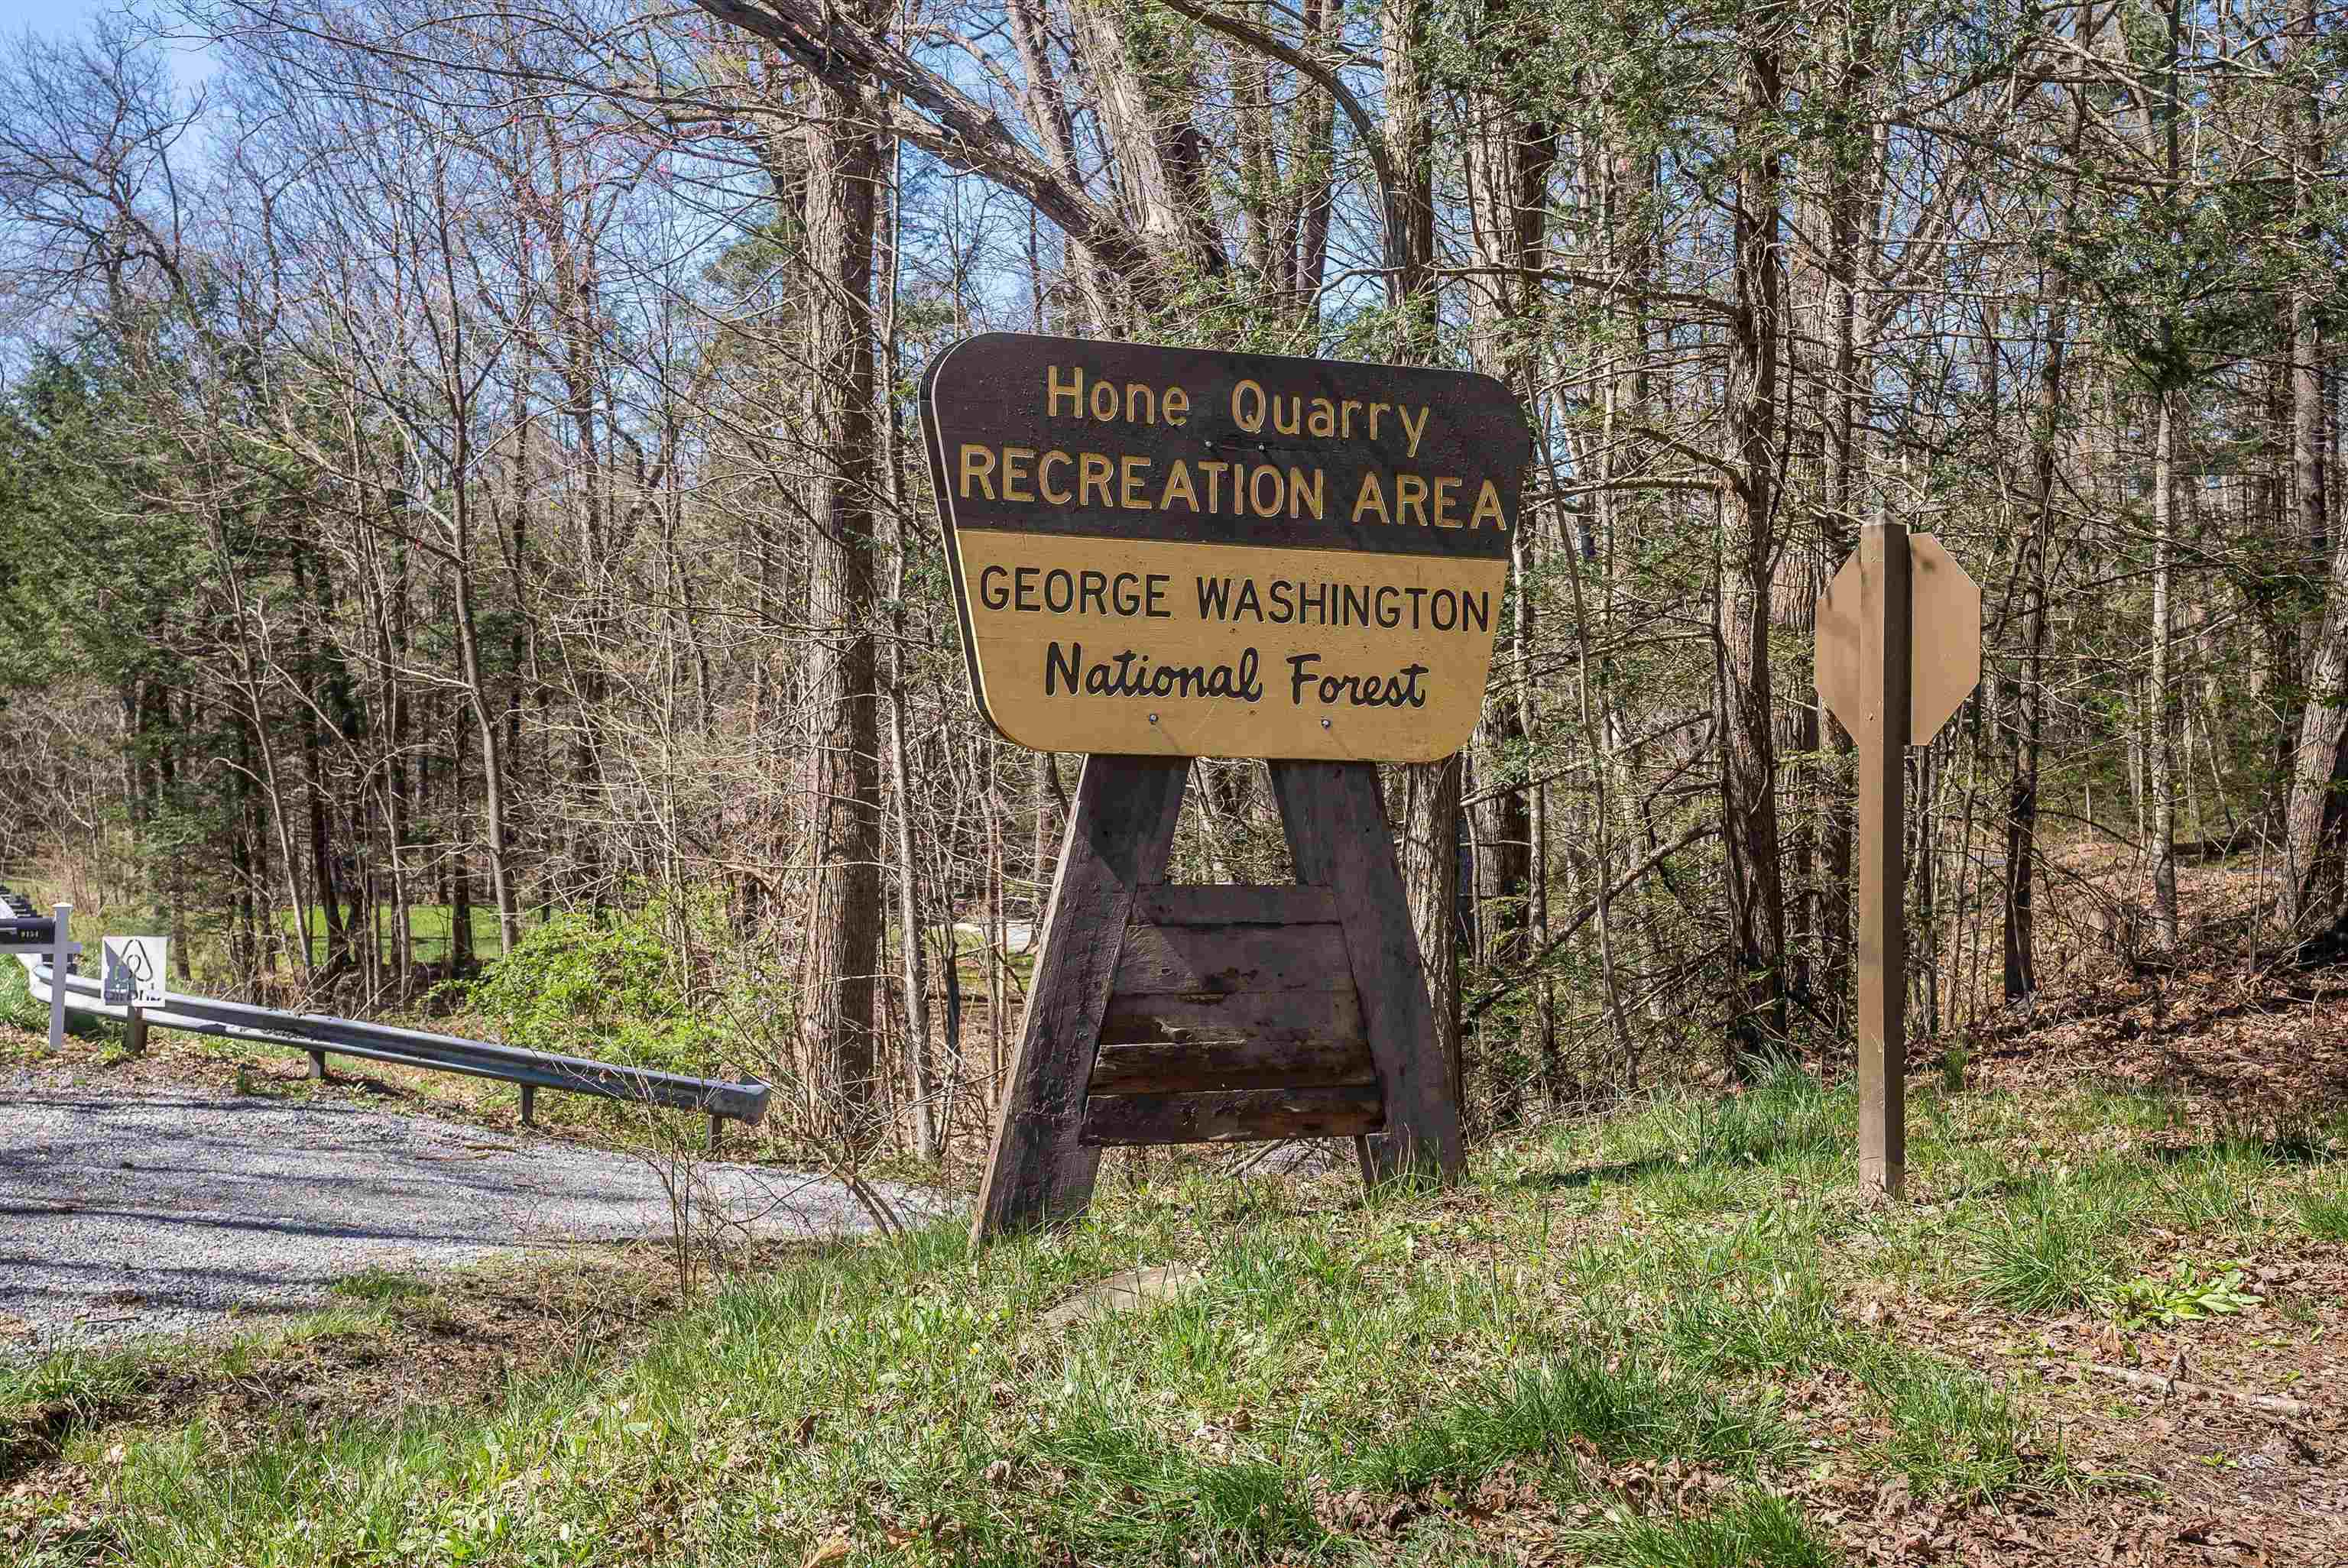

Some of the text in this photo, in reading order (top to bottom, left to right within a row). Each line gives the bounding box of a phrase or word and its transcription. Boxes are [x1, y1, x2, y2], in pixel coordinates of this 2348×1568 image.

[1046, 364, 1430, 458] Hone Quarry
[958, 442, 1508, 532] RECREATION AREA
[980, 565, 1490, 633] GEORGE WASHINGTON
[1044, 641, 1430, 710] National Forest
